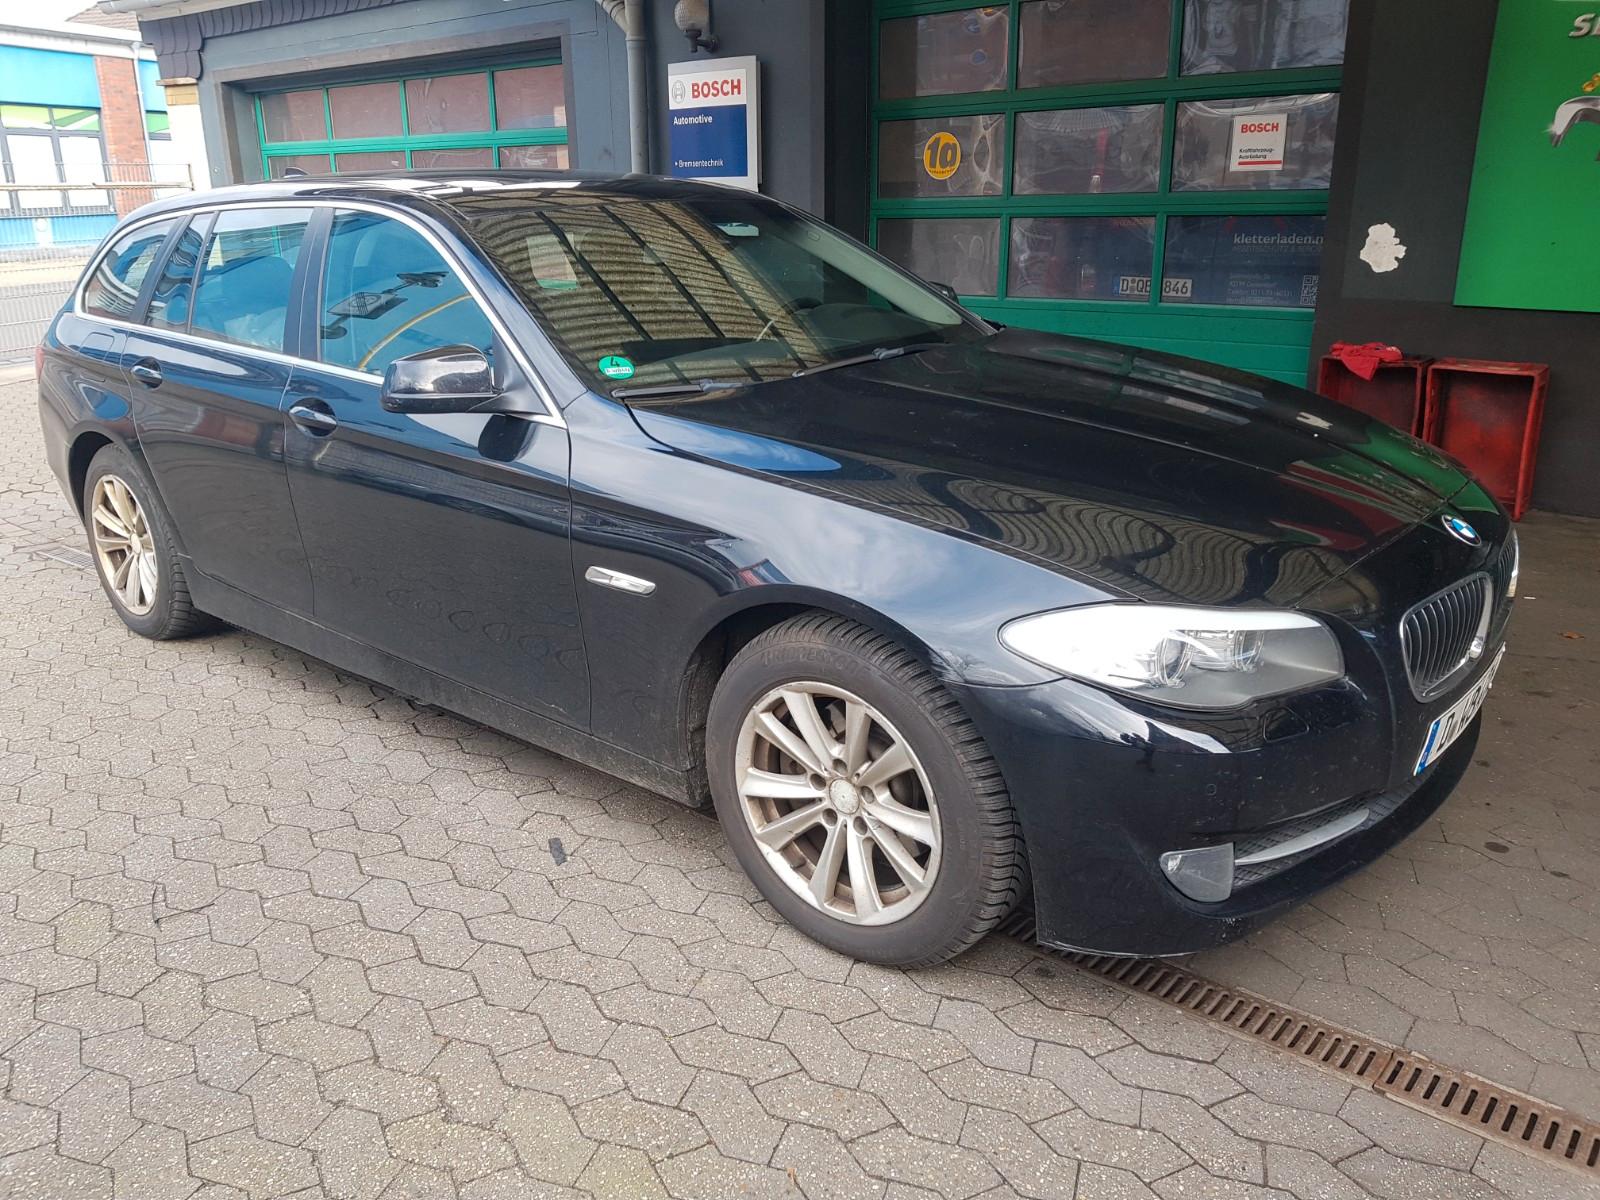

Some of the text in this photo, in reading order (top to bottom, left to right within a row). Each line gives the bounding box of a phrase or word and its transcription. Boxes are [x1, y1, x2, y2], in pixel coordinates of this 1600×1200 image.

[1568, 12, 1600, 38] S
[691, 78, 742, 99] BOSCH
[673, 114, 713, 126] Automotive
[1240, 121, 1280, 134] BOSCH
[678, 158, 724, 168] Bremsentechnik
[1121, 278, 1129, 293] D
[1163, 280, 1189, 295] 846
[610, 356, 620, 367] 4
